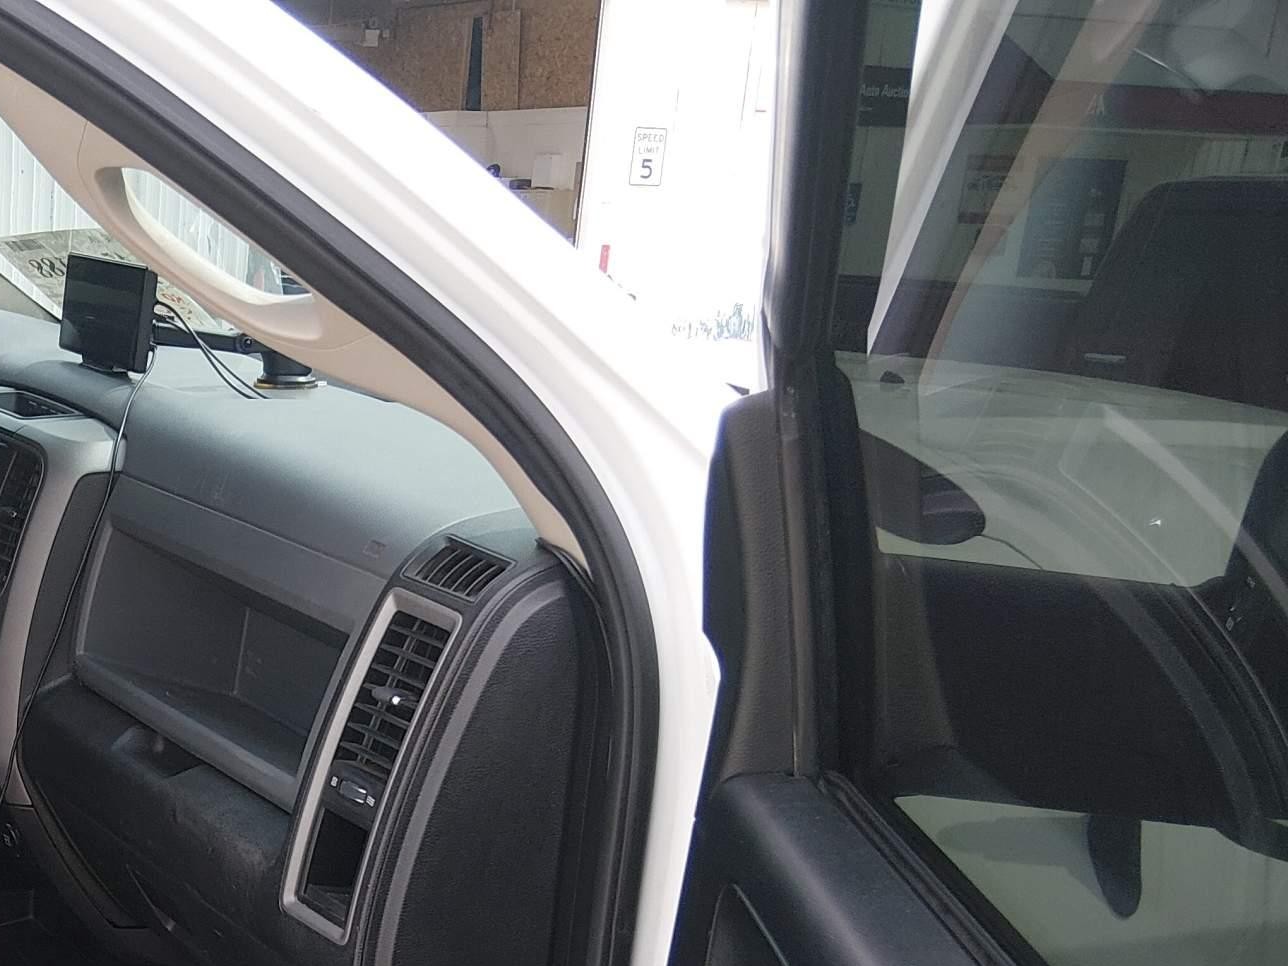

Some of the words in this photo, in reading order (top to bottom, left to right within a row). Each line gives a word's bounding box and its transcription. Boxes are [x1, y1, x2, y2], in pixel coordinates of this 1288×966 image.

[637, 133, 665, 143] SPEED
[638, 146, 660, 155] LIMIT
[639, 158, 653, 179] 5
